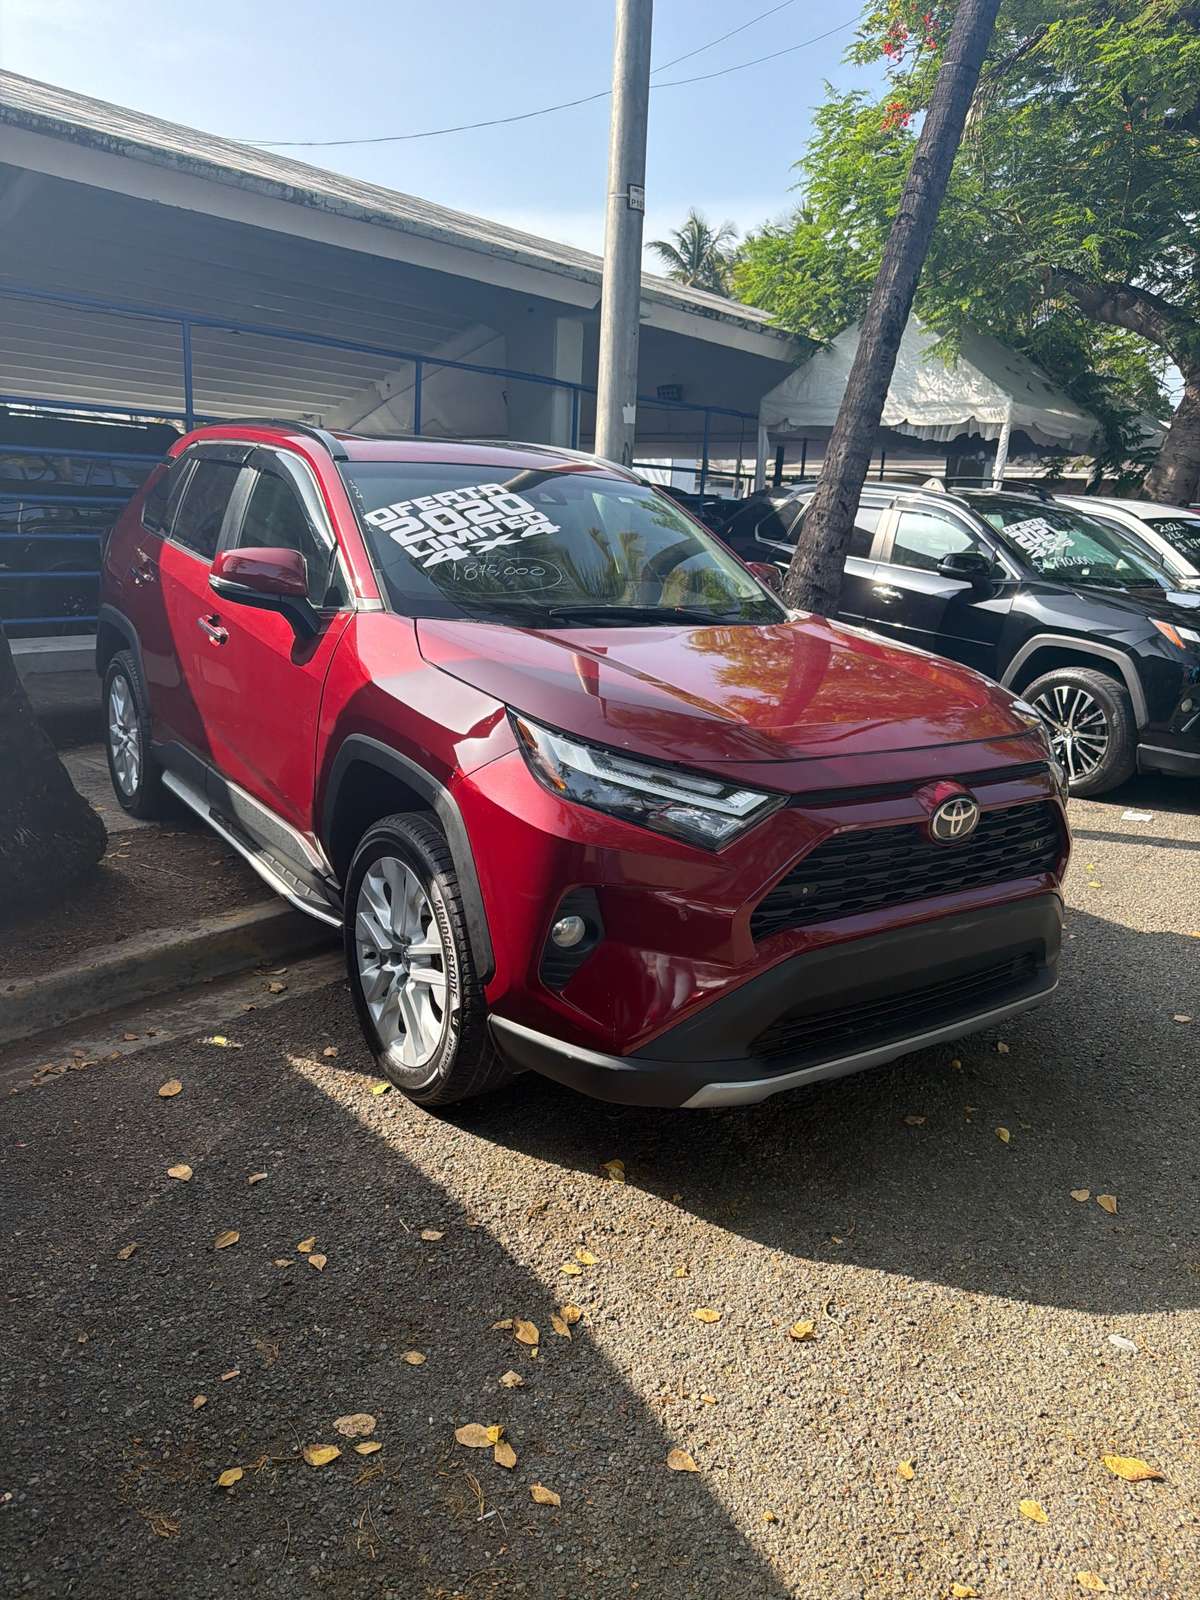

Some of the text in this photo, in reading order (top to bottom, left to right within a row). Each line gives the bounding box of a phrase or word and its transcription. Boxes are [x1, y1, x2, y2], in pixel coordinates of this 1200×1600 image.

[364, 483, 509, 526] OFERTA
[378, 493, 535, 547] 2020
[404, 511, 550, 559] LIMITED
[1008, 524, 1058, 549] 2021
[434, 900, 458, 1000] BRIDGESTONE
